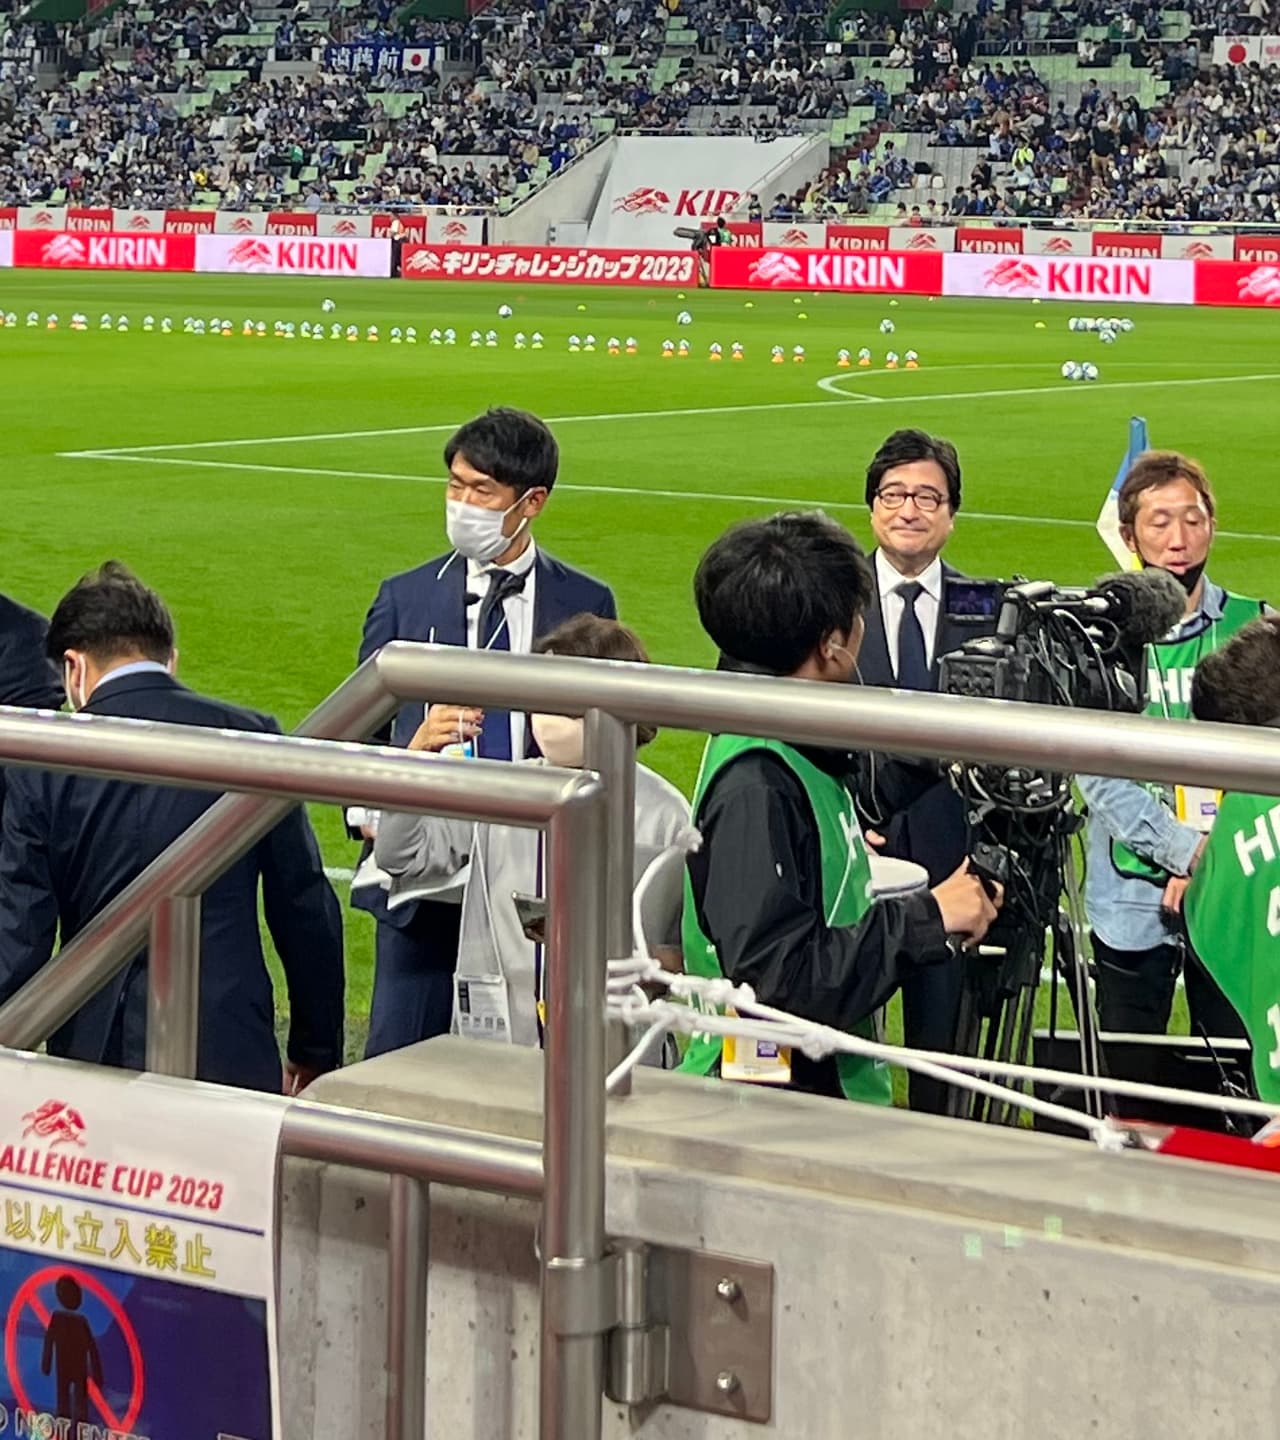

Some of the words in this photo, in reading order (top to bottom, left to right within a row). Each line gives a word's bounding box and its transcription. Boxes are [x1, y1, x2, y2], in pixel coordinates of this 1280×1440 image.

[89, 236, 166, 267] KIRIN
[277, 240, 358, 271] KIRIN
[808, 252, 906, 288] KIRIN
[1048, 261, 1152, 296] KIRIN
[111, 1164, 164, 1202] CUP
[166, 1173, 225, 1211] 2023
[14, 1406, 72, 1440] NOT
